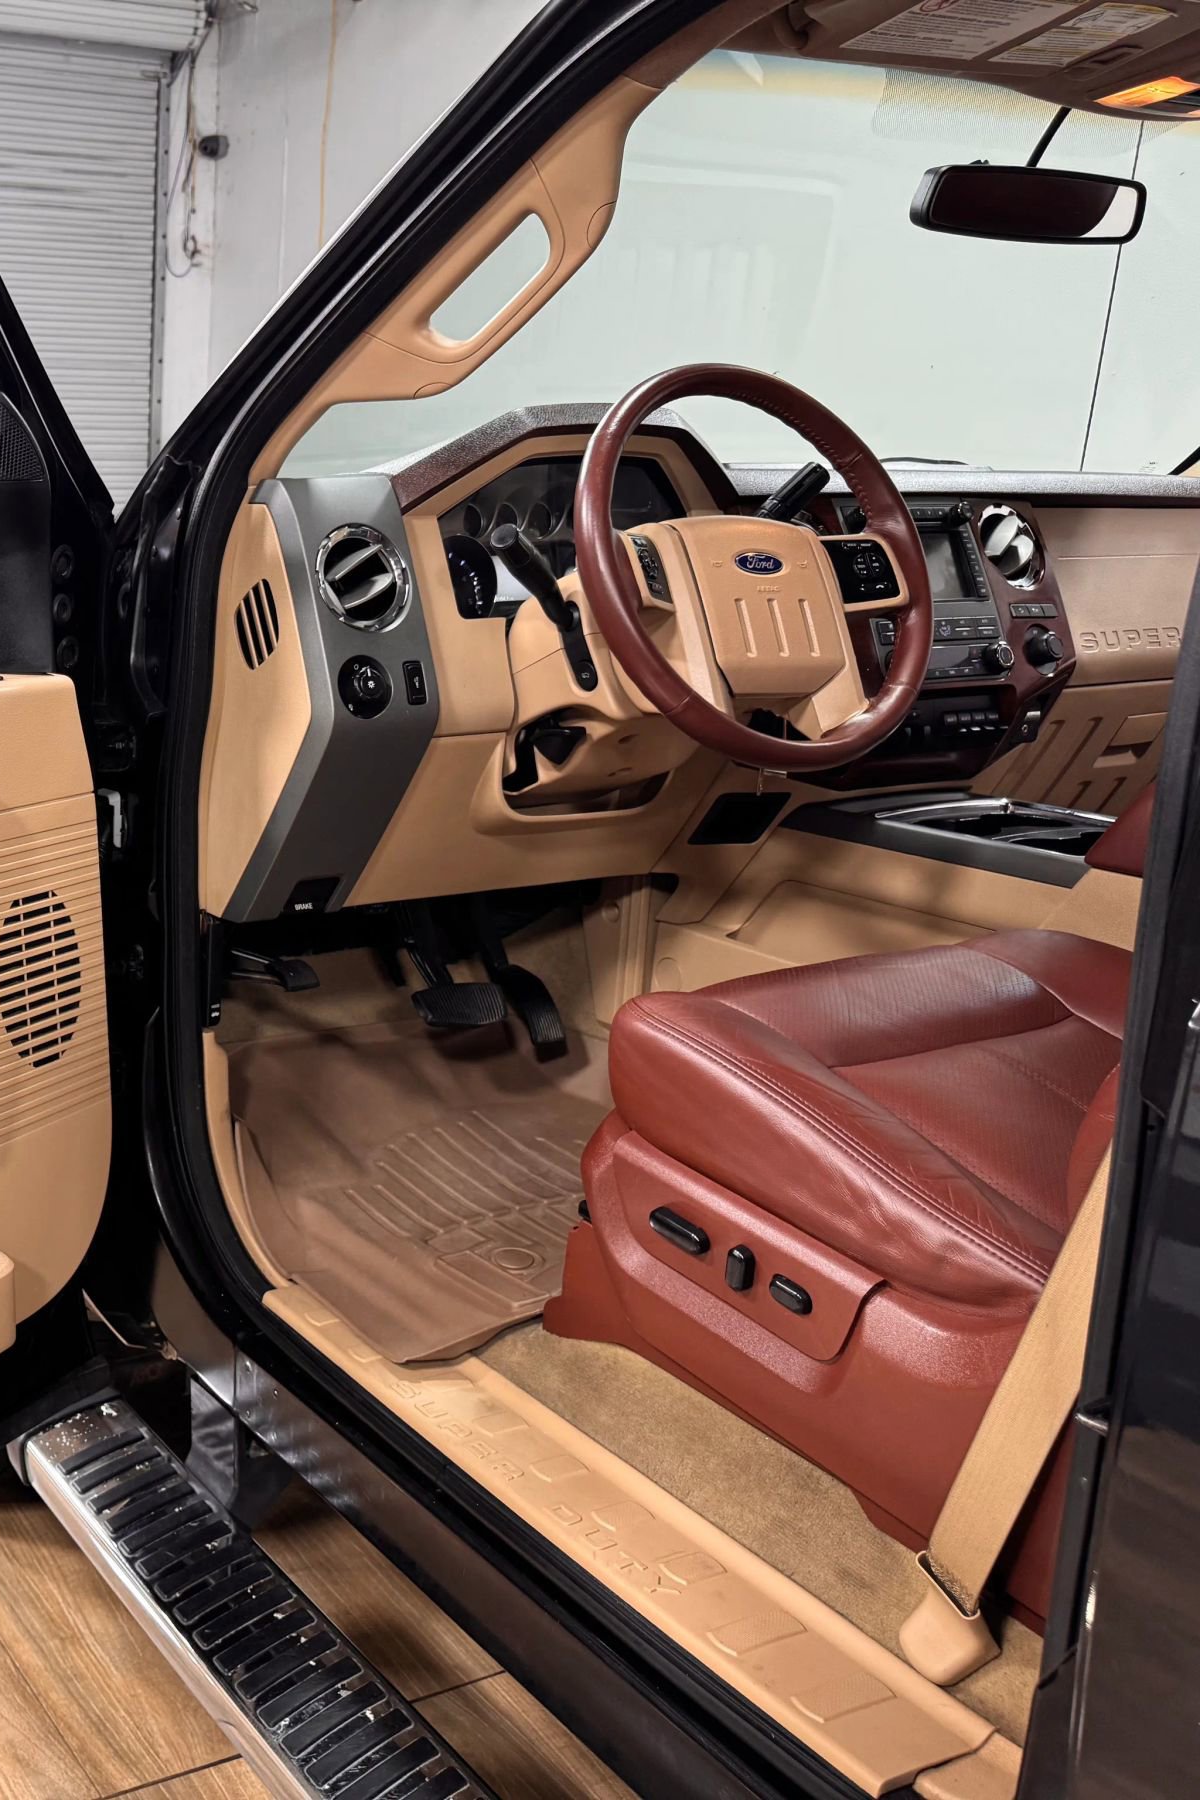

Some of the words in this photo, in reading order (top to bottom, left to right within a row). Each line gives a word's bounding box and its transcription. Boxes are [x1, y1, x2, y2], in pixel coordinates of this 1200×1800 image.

[746, 554, 775, 569] Ford
[1080, 626, 1181, 653] SUPER
[294, 902, 313, 911] BRAKE
[391, 1380, 525, 1482] SUPER
[552, 1503, 682, 1595] DUTY
